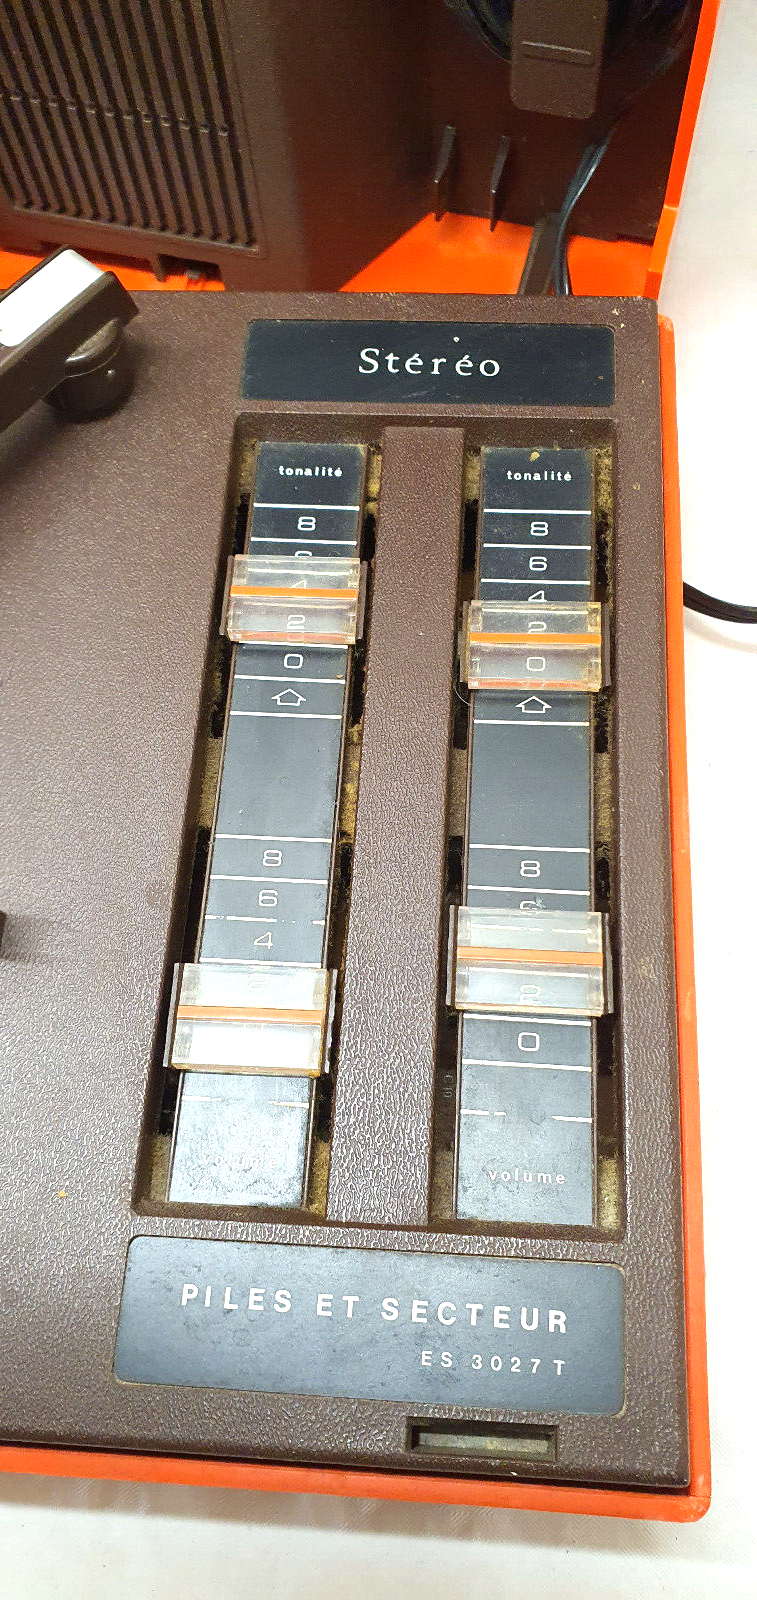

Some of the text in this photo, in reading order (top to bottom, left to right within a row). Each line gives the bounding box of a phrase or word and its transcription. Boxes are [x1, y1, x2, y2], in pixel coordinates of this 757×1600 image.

[358, 347, 501, 377] Stéréo
[278, 464, 343, 478] tonalité
[506, 469, 572, 482] tonalité
[297, 516, 317, 532] 8
[529, 521, 549, 537] 8
[528, 556, 548, 572] 6
[286, 614, 306, 630] 2
[283, 653, 304, 669] 0
[526, 656, 546, 672] 0
[261, 849, 283, 868] 8
[519, 860, 541, 878] 8
[257, 889, 279, 908] 6
[252, 931, 275, 951] 4
[517, 1031, 541, 1052] 0
[488, 1167, 567, 1185] volume
[181, 1283, 567, 1334] PILES ET SECTEUR
[421, 1350, 566, 1376] ES 3027 T
